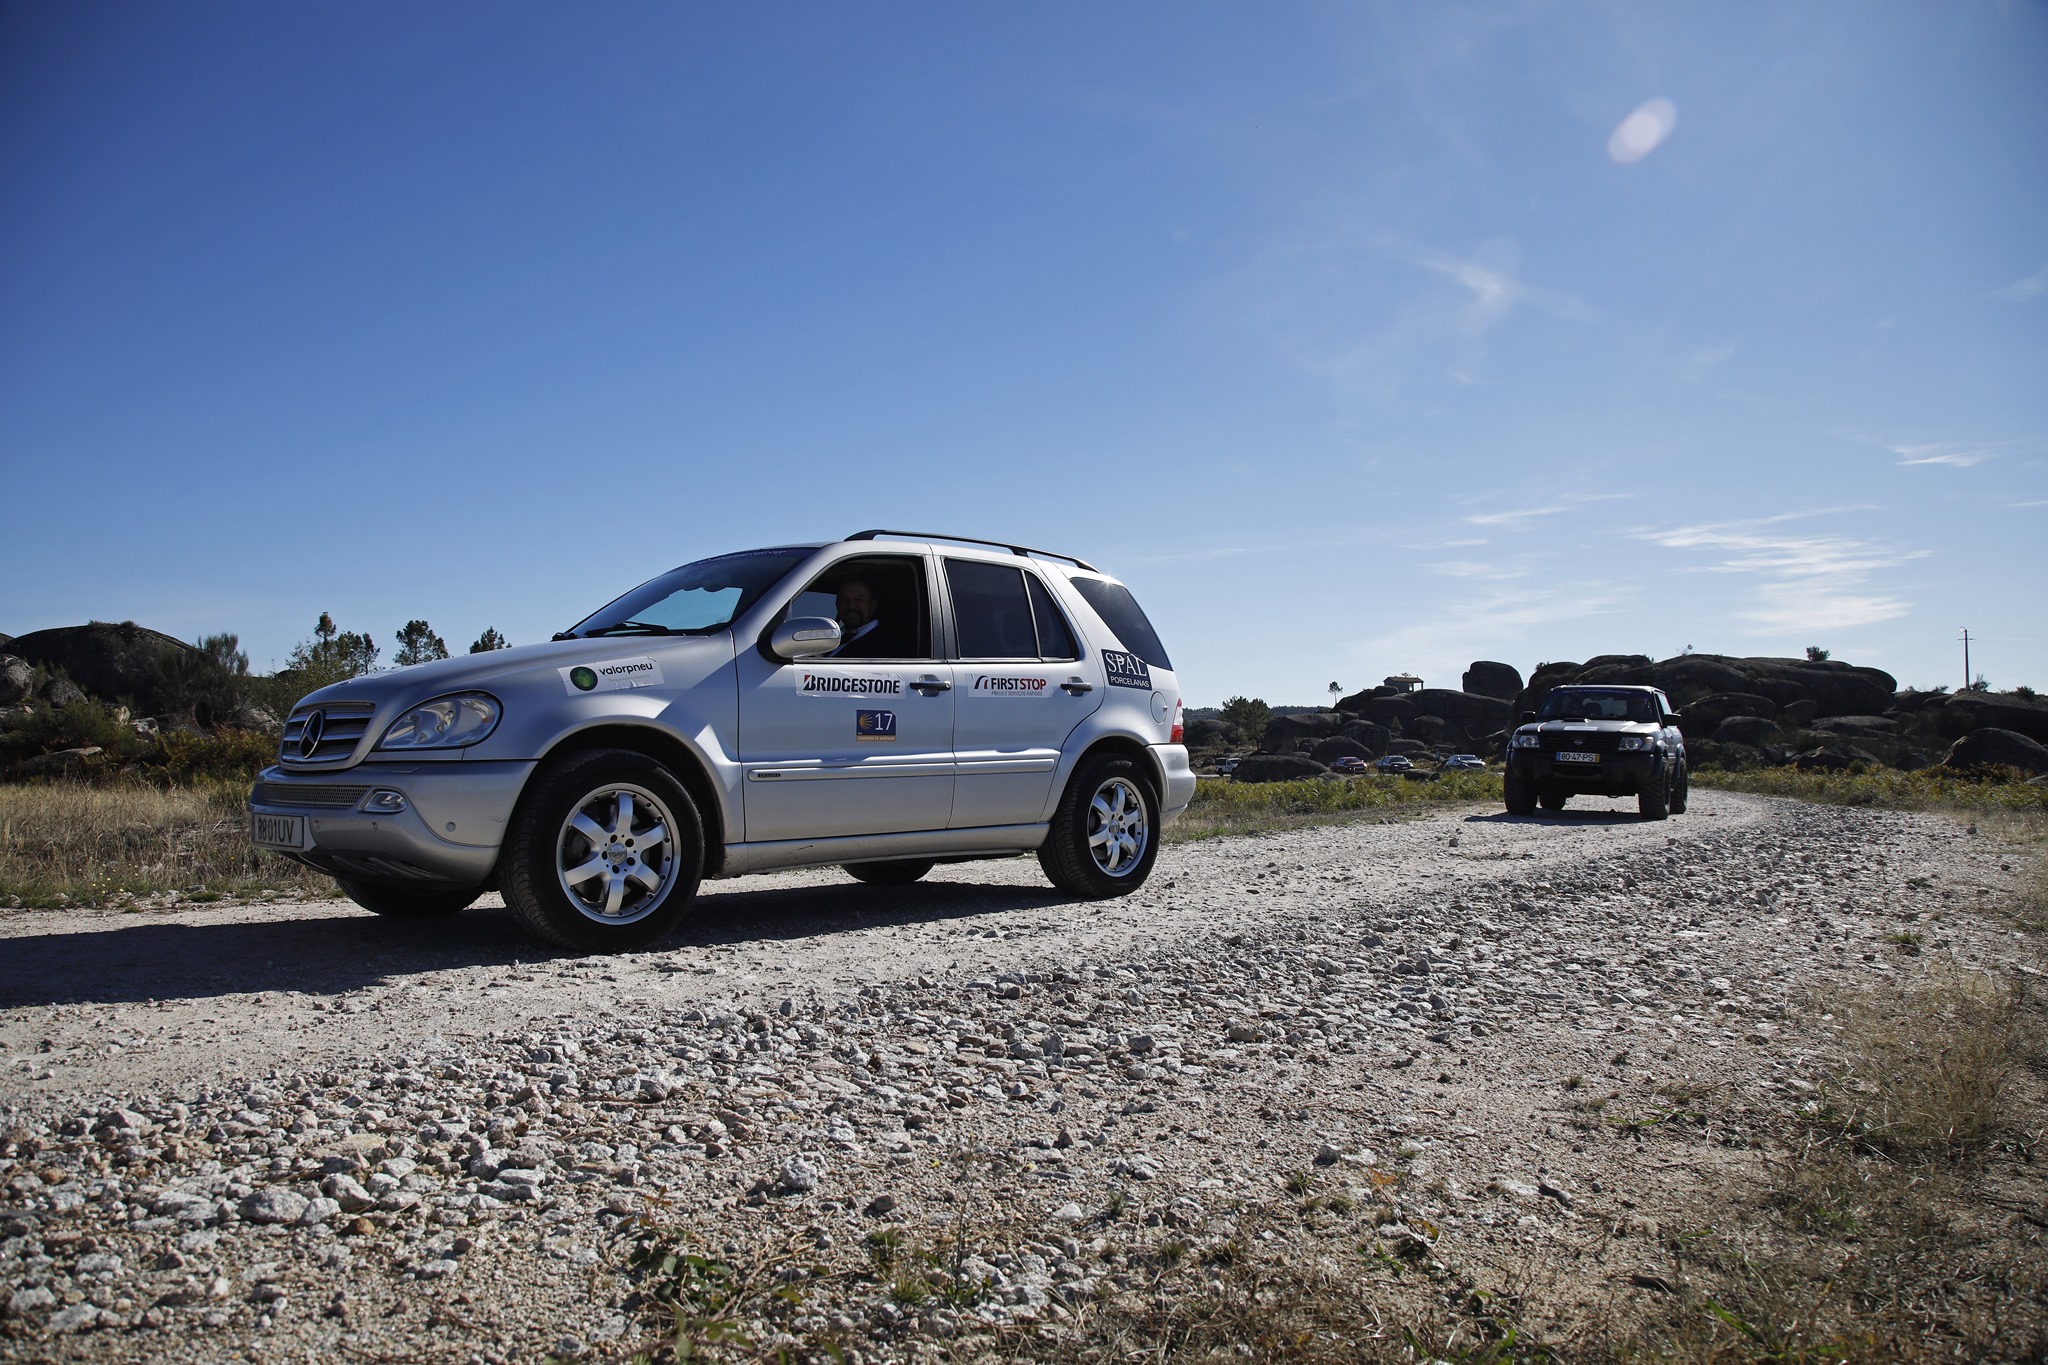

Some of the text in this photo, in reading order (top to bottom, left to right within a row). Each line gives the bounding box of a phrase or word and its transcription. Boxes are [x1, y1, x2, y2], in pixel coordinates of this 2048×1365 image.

[599, 662, 653, 676] valorpneu
[1106, 652, 1147, 677] SPAL
[803, 674, 900, 694] BRIDGESTONE
[1110, 676, 1149, 688] PORCELANAS
[875, 713, 893, 731] 17
